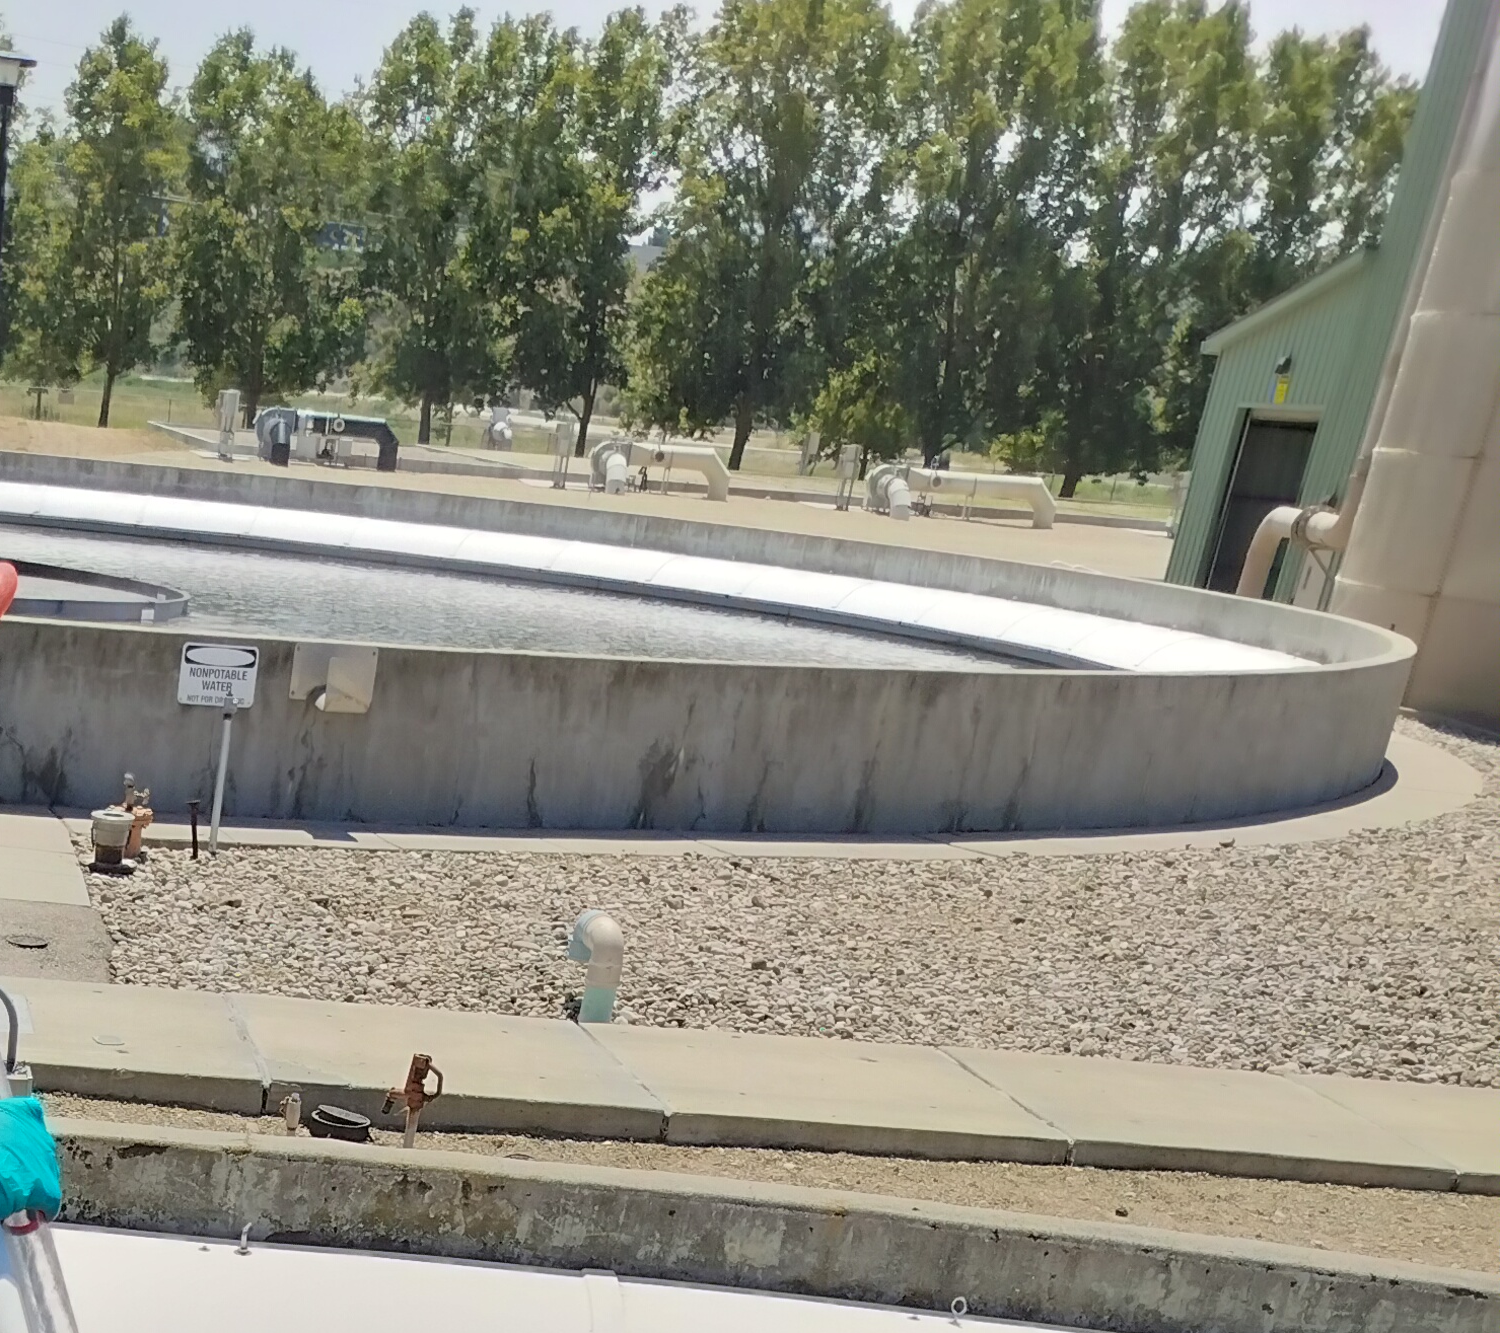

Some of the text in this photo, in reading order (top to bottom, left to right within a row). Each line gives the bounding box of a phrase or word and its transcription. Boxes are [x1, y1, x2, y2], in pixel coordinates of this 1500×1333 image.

[189, 667, 248, 681] NONPOTABLE
[202, 680, 233, 692] WATER
[186, 694, 200, 703] NOT
[200, 695, 214, 704] FOR
